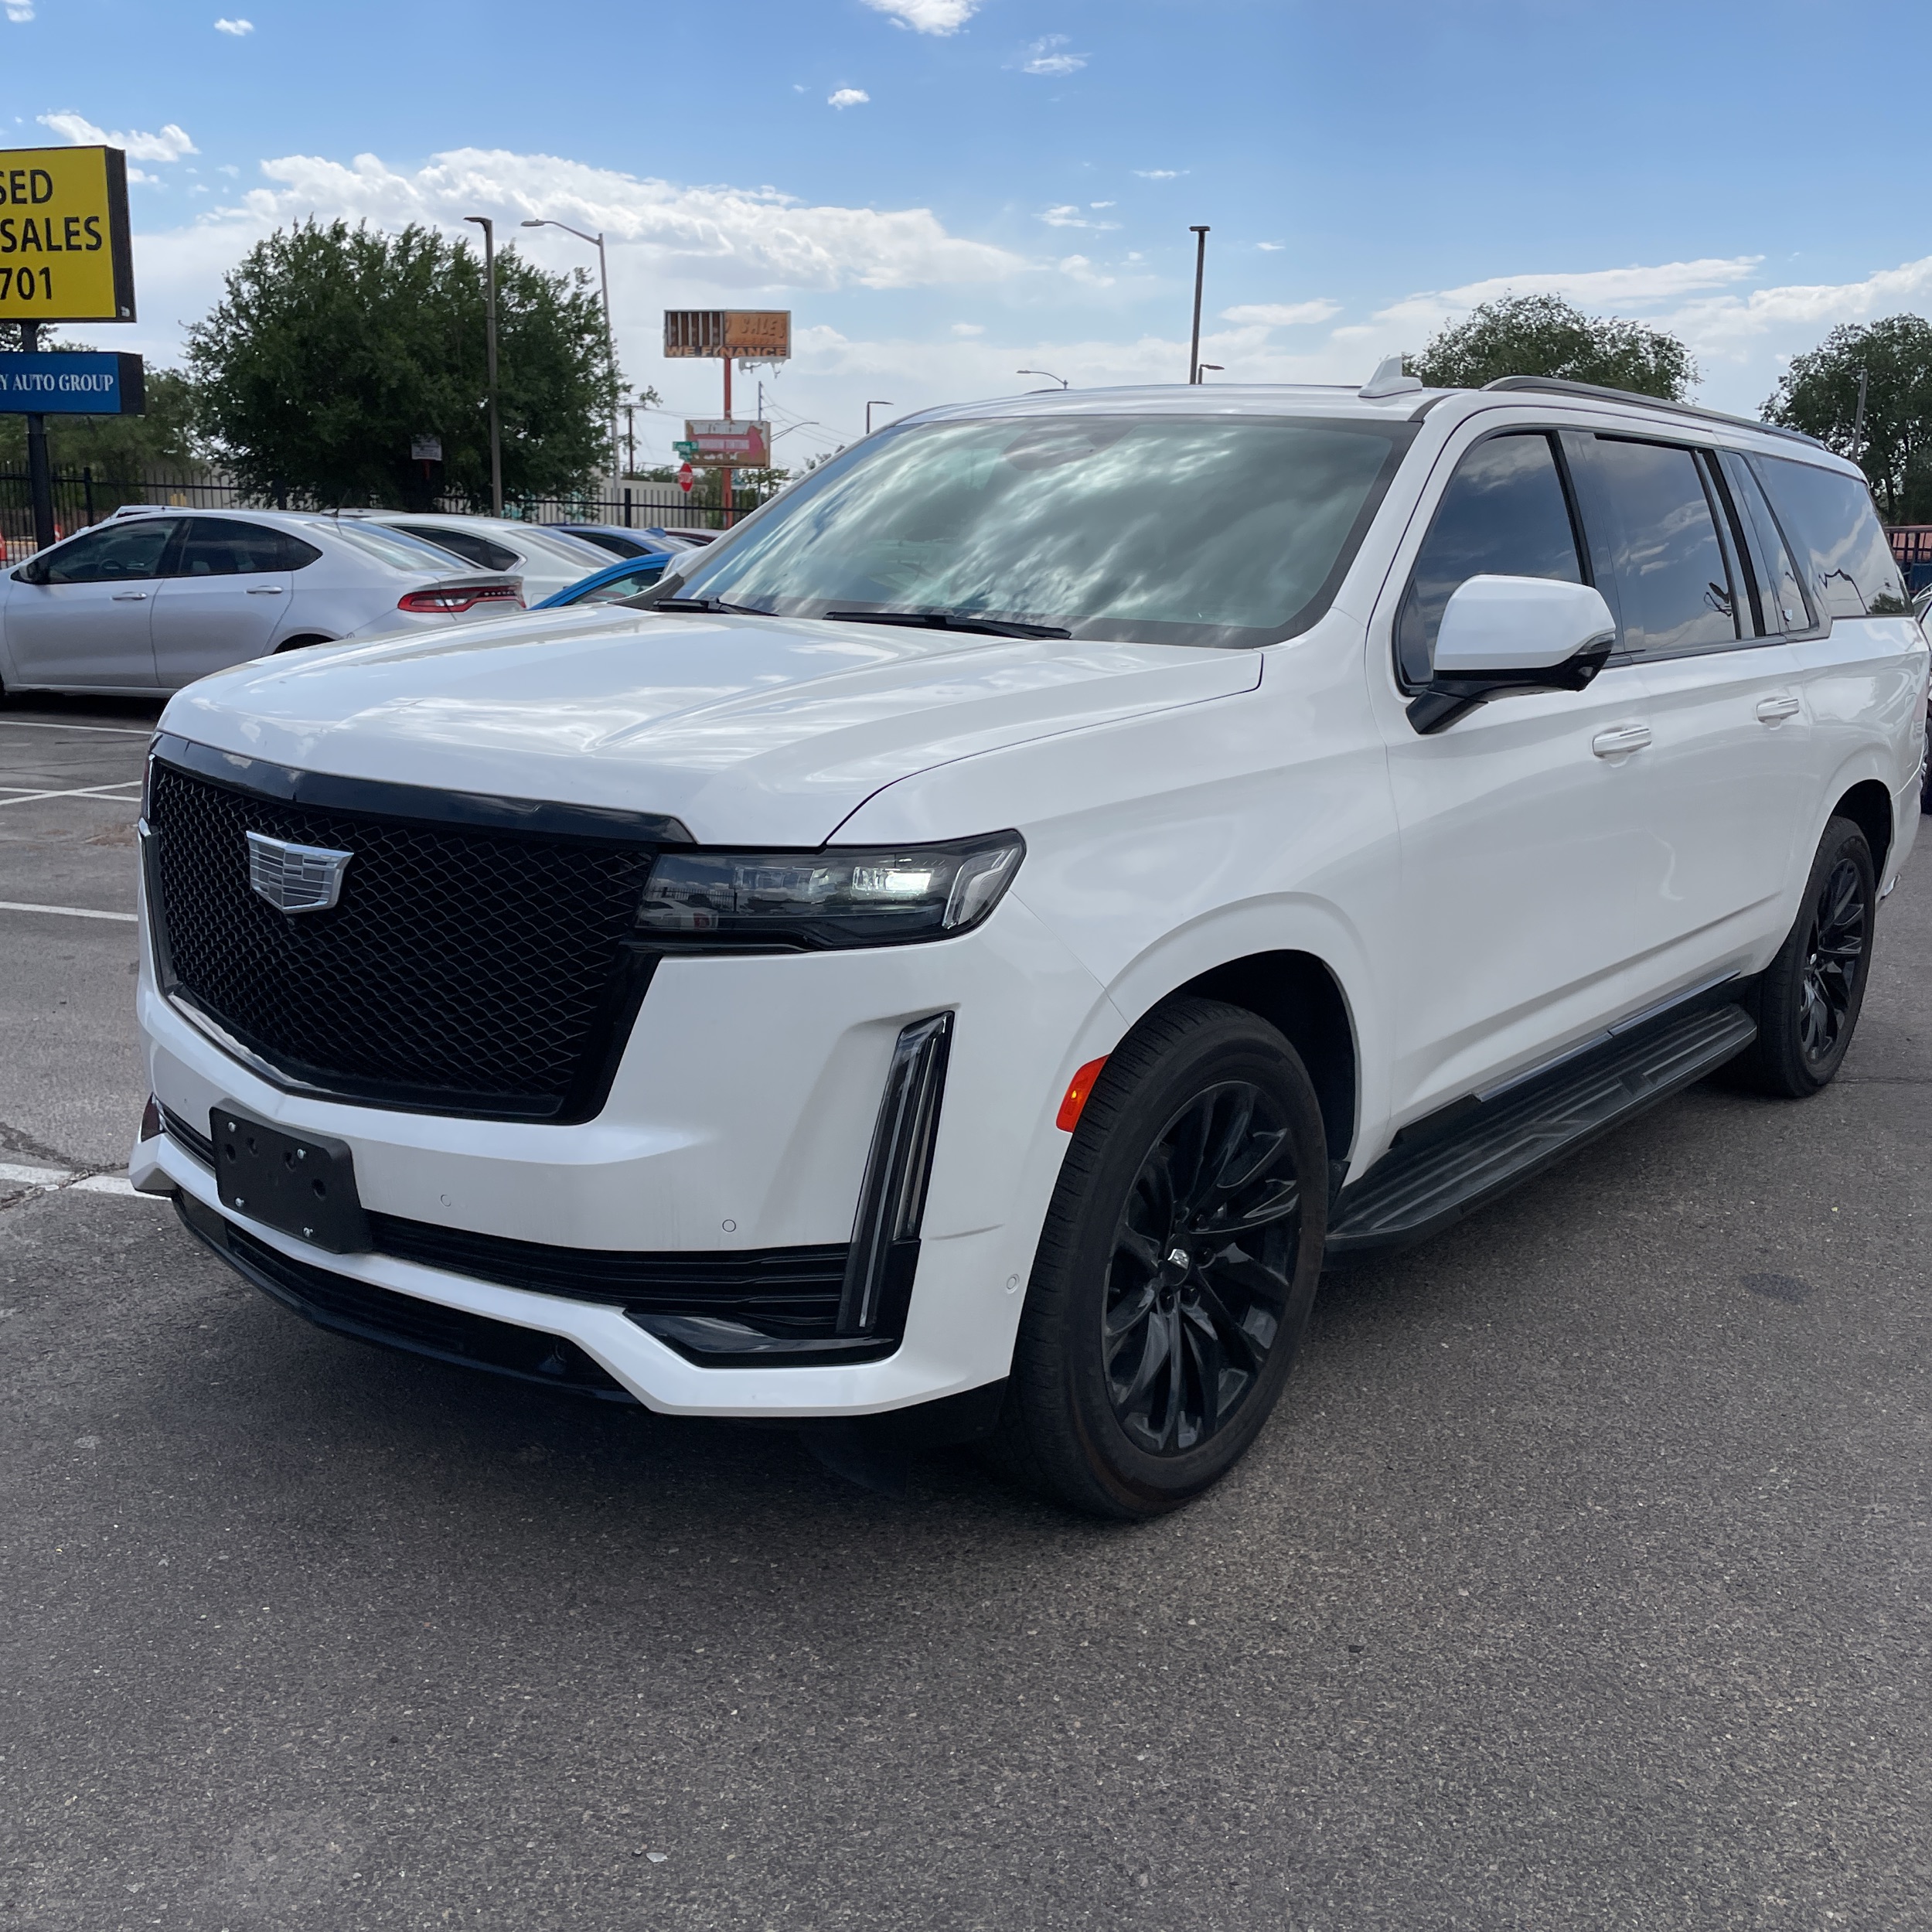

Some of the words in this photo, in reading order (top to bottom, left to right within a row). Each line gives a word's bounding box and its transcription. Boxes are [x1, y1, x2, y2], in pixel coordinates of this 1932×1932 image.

[1, 216, 102, 253] SALES
[666, 346, 695, 357] WE
[700, 346, 787, 357] FINANCE
[12, 373, 55, 391] AUTO
[59, 373, 114, 392] GROUP
